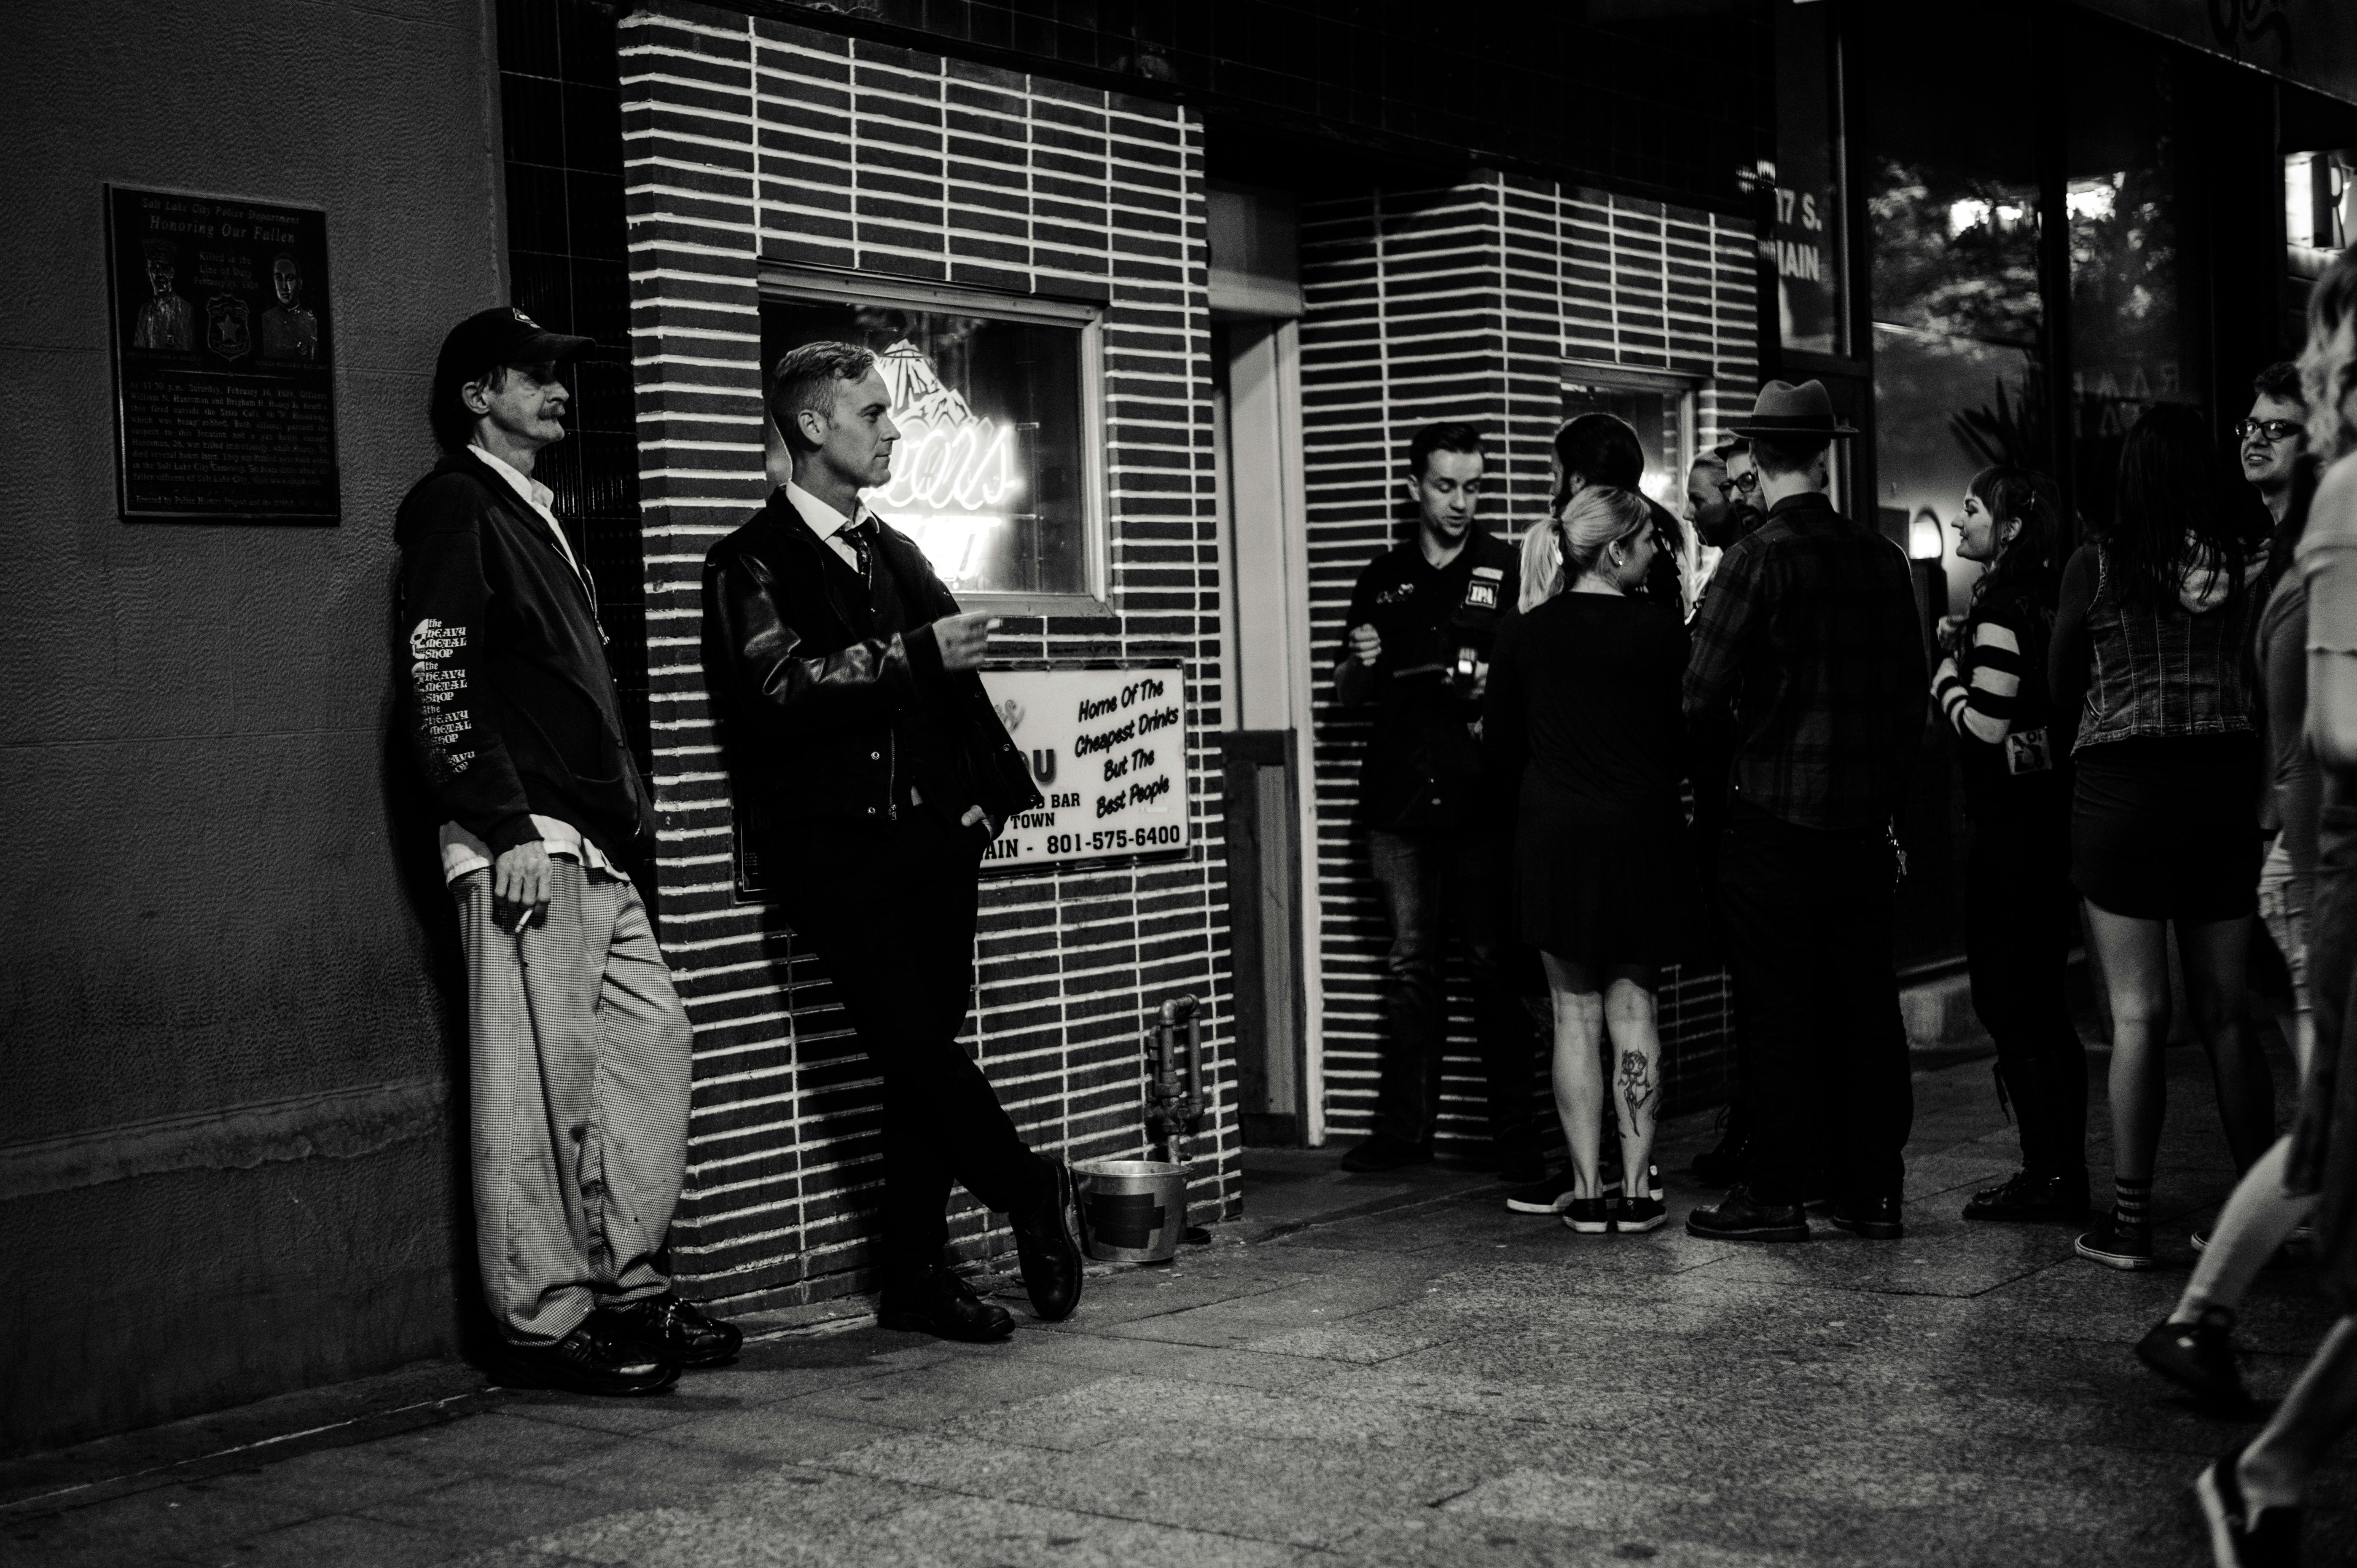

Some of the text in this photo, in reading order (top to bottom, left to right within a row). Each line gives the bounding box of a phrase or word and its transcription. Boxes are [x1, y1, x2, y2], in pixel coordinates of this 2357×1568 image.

[142, 197, 299, 226] Salt Lake City Police Department
[1802, 193, 1822, 231] S.
[149, 215, 294, 243] Honoring Our Fallen
[199, 251, 251, 264] Killed in the
[199, 264, 252, 279] Line of Duty
[188, 384, 222, 395] Saturday,
[227, 387, 257, 397] February
[300, 391, 327, 399] Officers
[130, 392, 159, 401] William
[173, 395, 208, 403] Huntsman
[226, 397, 255, 408] Brigham
[173, 406, 199, 414] outside
[132, 427, 159, 437] suspect
[177, 418, 197, 427] being
[287, 423, 313, 432] pursued
[132, 438, 170, 448] Huntsman,
[223, 453, 238, 462] They
[194, 463, 209, 472] City
[164, 497, 172, 505] by
[198, 497, 221, 506] History
[224, 498, 246, 507] Project
[429, 618, 442, 627] the
[425, 637, 467, 647] METAL
[425, 661, 438, 670] the
[425, 679, 468, 692] METAL
[1078, 679, 1163, 722] Home Of The
[427, 706, 441, 714] the
[430, 720, 472, 735] METAL
[1075, 706, 1179, 757] Cheapest Drinks
[1104, 748, 1155, 782] But The
[1051, 793, 1080, 808] BAR
[1097, 775, 1169, 818] Best People
[1011, 812, 1055, 829] TOWN
[981, 839, 1018, 860] AIN
[1047, 825, 1180, 855] 801-575-6400
